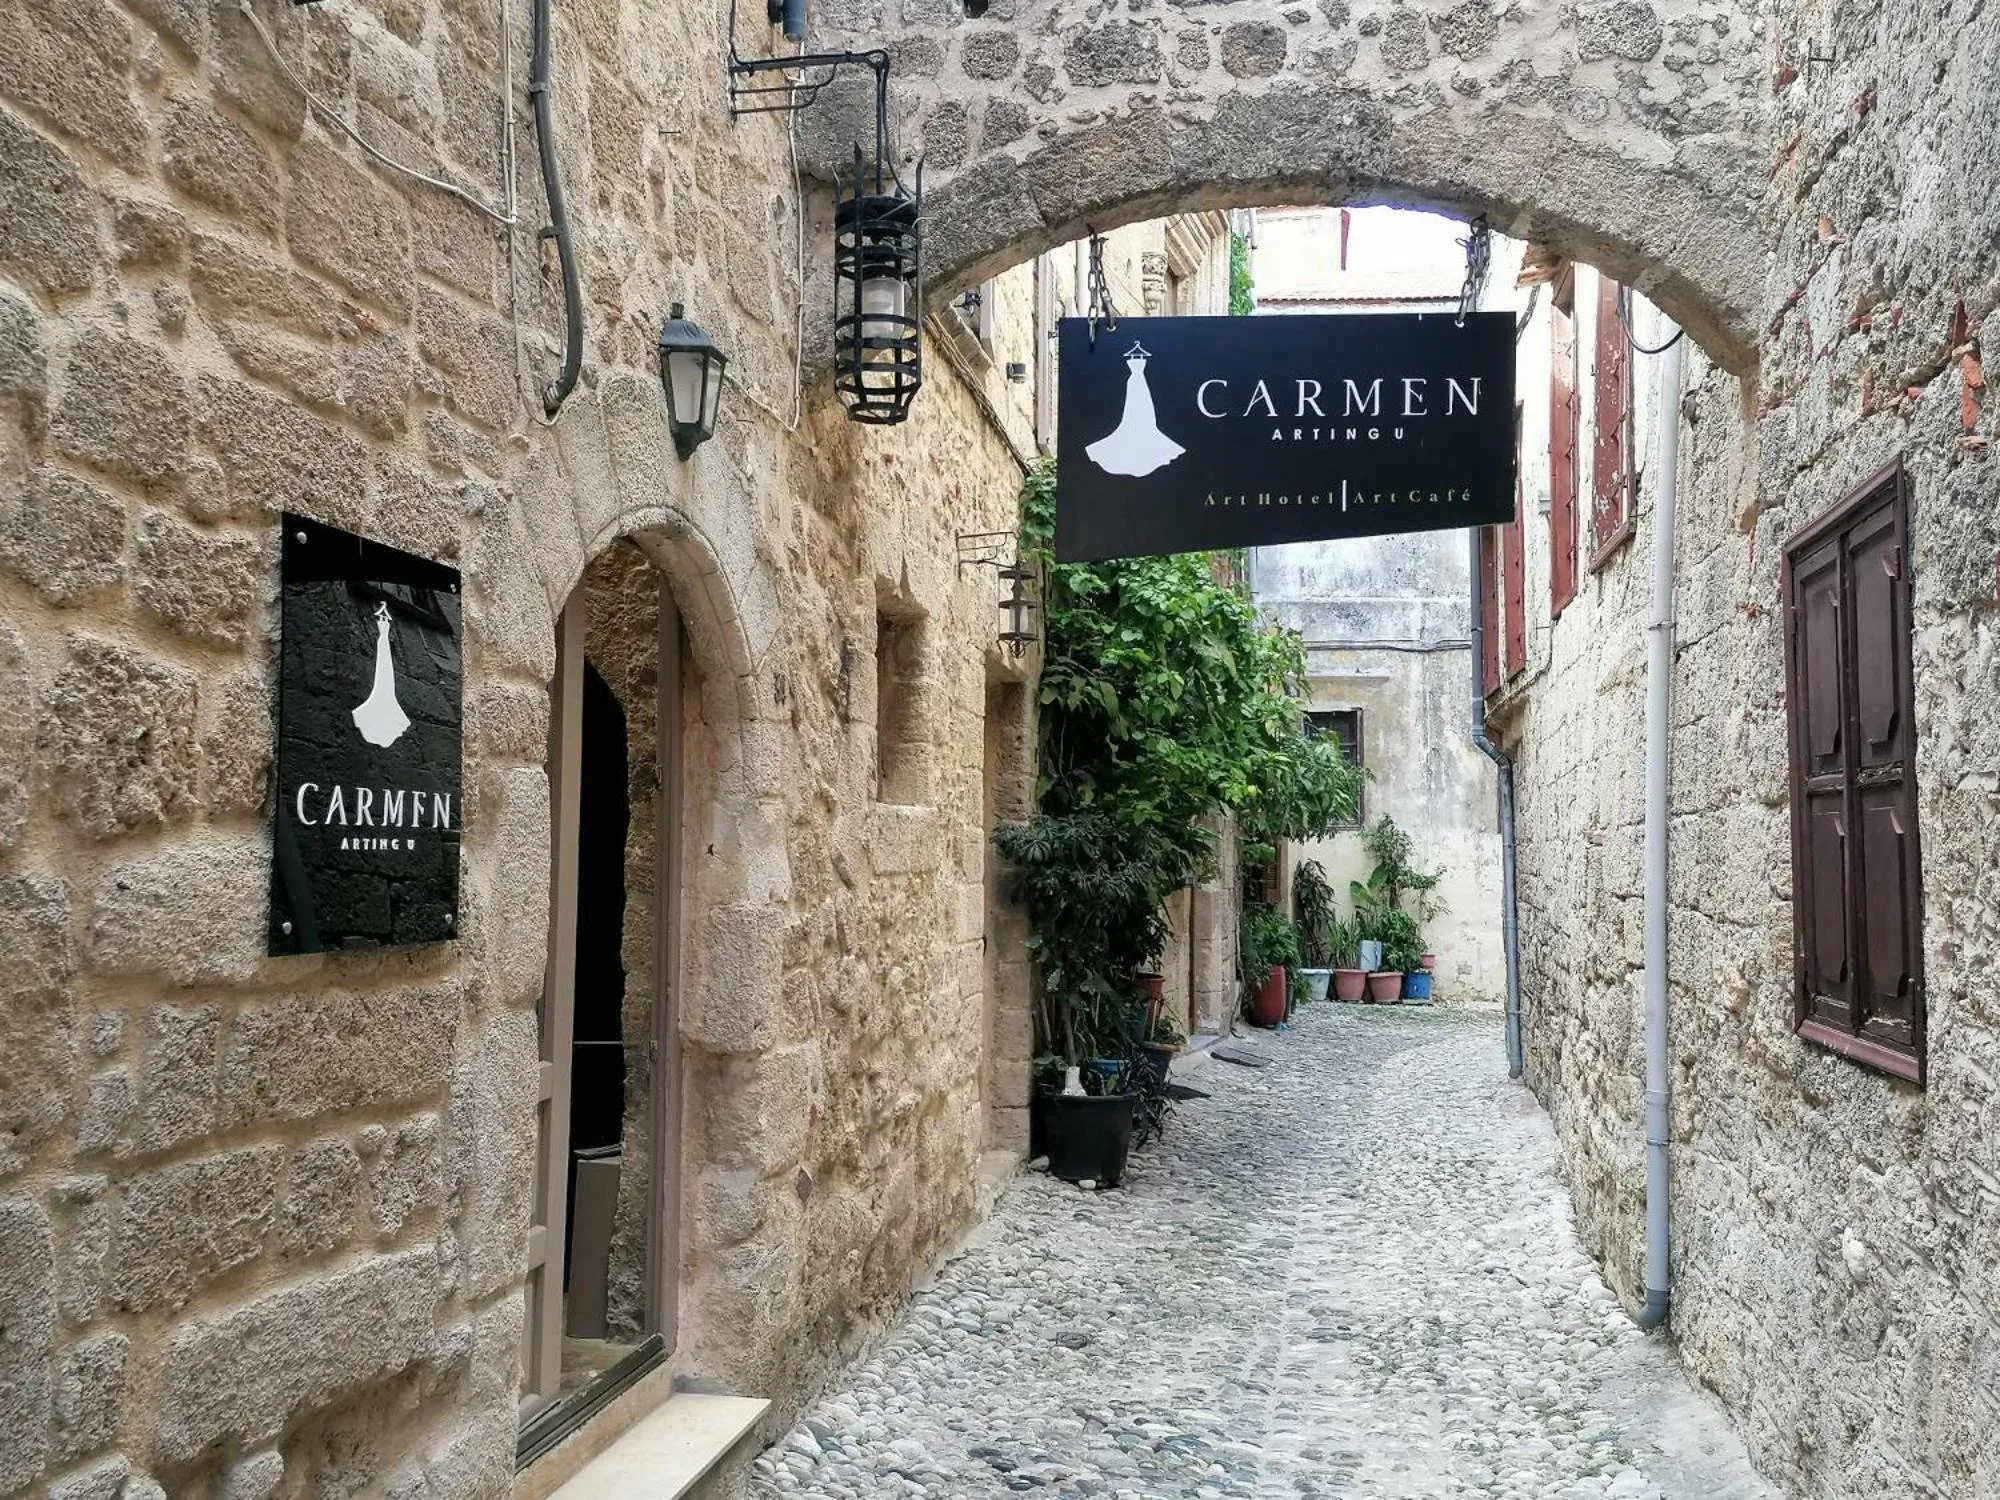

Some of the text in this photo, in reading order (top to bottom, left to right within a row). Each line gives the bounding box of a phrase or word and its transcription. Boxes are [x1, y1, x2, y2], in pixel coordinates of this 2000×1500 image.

[1197, 377, 1481, 418] CARMEN
[1272, 428, 1404, 440] ARTINGU
[1204, 488, 1470, 507] Art Hotel Art Café
